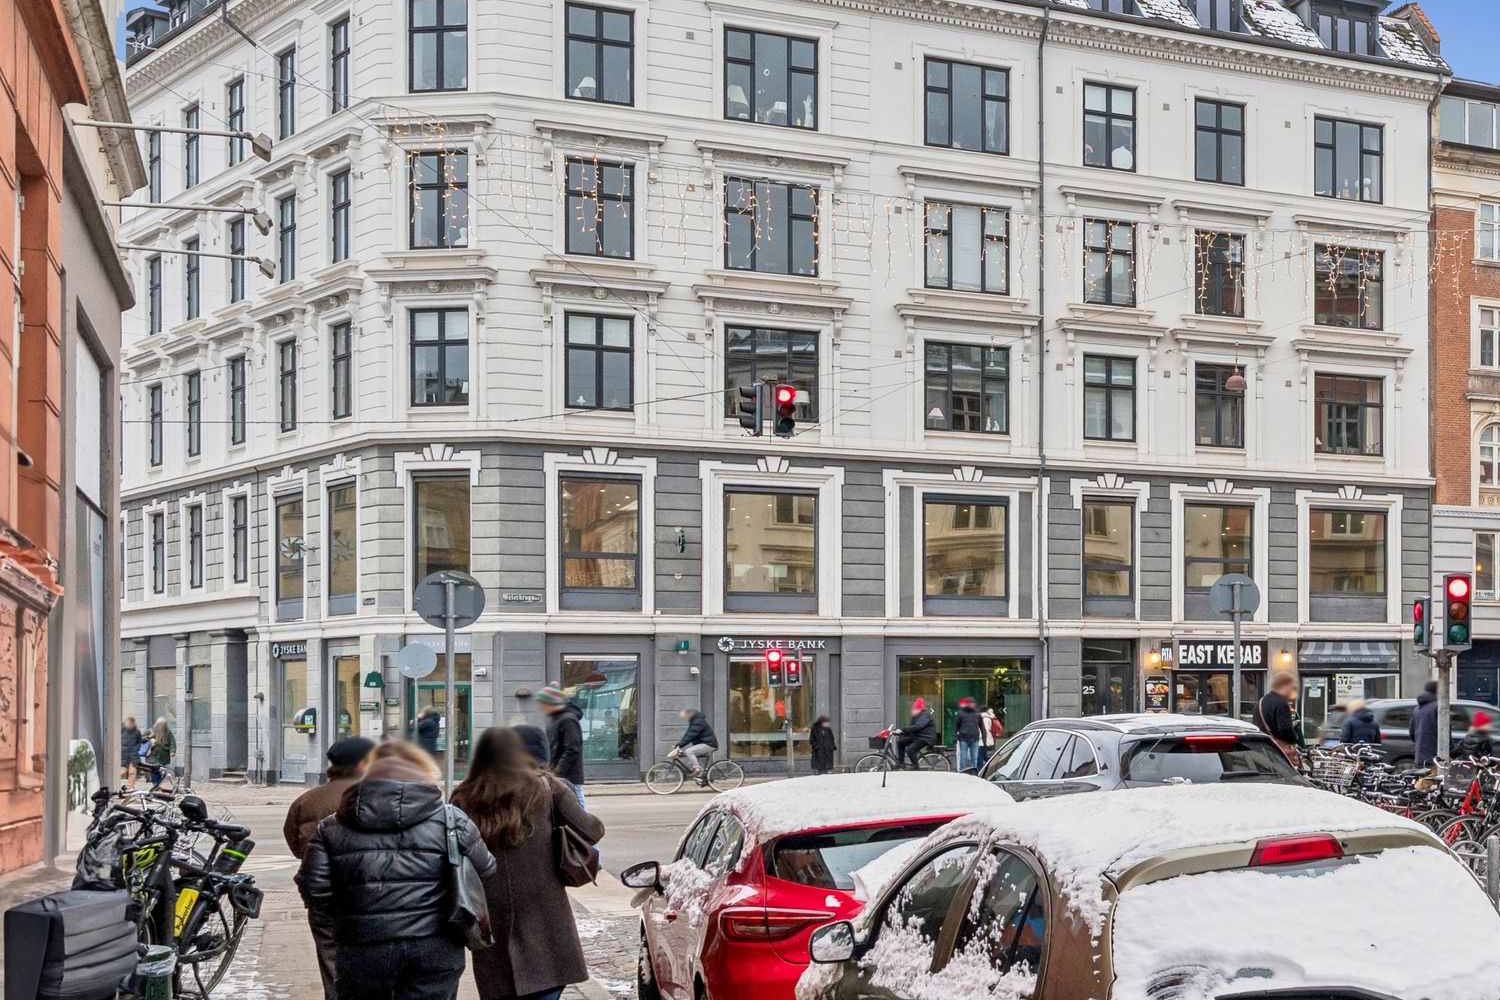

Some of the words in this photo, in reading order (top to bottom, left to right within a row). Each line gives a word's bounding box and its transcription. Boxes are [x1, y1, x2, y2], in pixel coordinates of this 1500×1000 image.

[740, 640, 783, 649] JYSKE
[788, 640, 826, 649] BANK
[1161, 647, 1173, 661] PITA
[1179, 644, 1214, 665] EAST
[1082, 685, 1096, 695] 25
